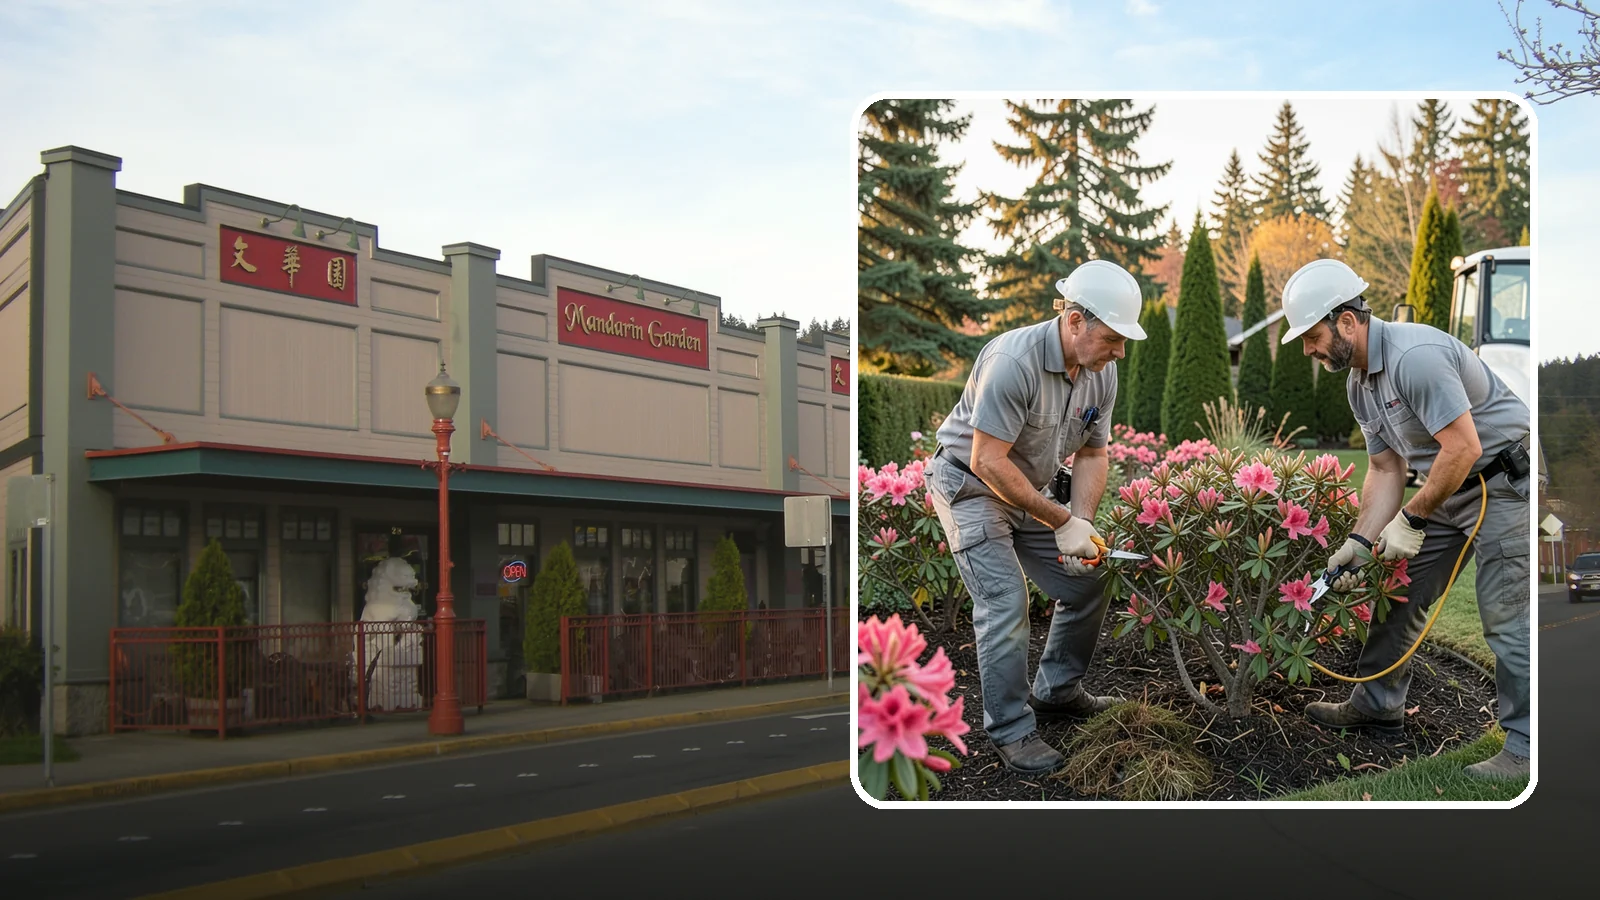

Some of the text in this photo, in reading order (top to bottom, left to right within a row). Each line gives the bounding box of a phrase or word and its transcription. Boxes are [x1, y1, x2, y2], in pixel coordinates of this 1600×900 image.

[231, 235, 346, 291] 文華園
[564, 302, 702, 352] Mandarin Garden
[503, 565, 526, 578] OPEN
